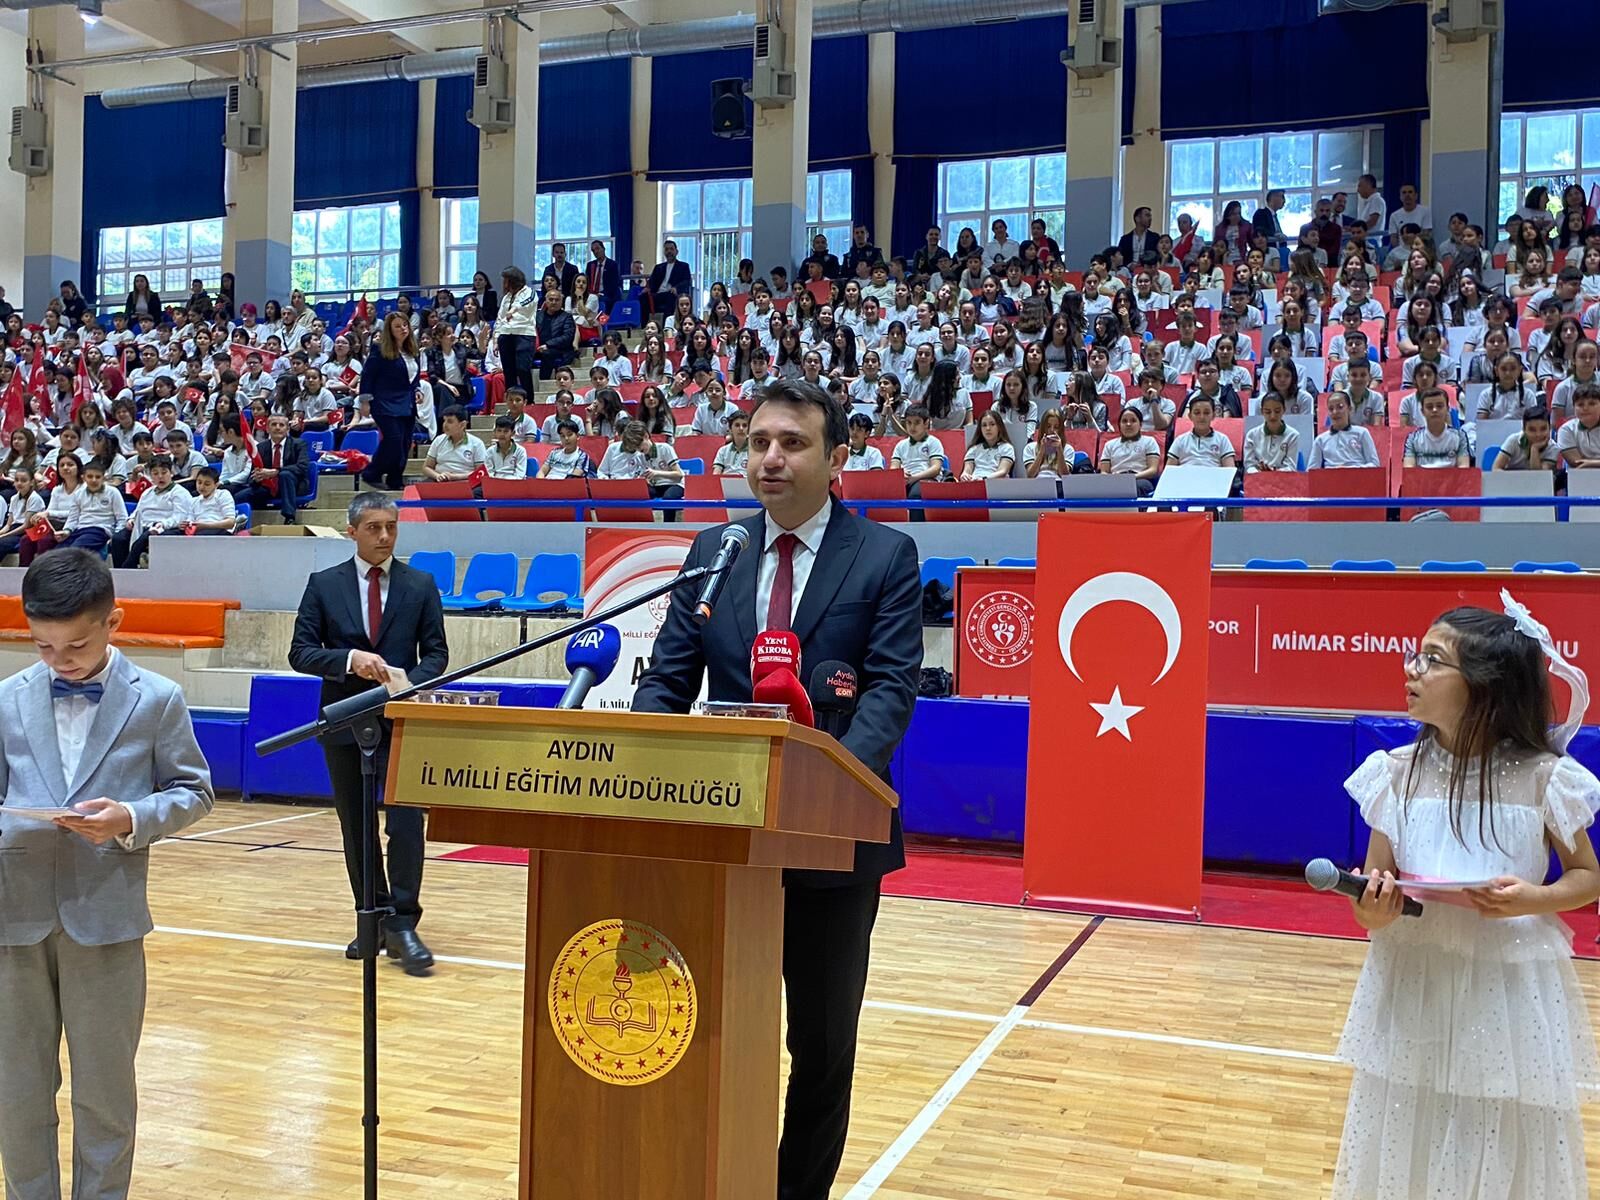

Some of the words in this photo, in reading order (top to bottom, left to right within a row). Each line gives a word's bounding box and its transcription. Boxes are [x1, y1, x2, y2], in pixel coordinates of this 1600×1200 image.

[623, 631, 642, 639] MİLLİ
[1208, 620, 1239, 635] POR
[572, 629, 600, 649] AA
[1272, 630, 1346, 652] MİMAR
[1351, 632, 1417, 654] SİNAN
[757, 646, 792, 656] KIROBA
[547, 739, 615, 763] AYDIN
[421, 761, 437, 786] İL
[443, 764, 500, 790] MİLLİ
[505, 767, 582, 797] EĞİTİM
[588, 773, 742, 808] MÜDÜRLÜĞÜ
